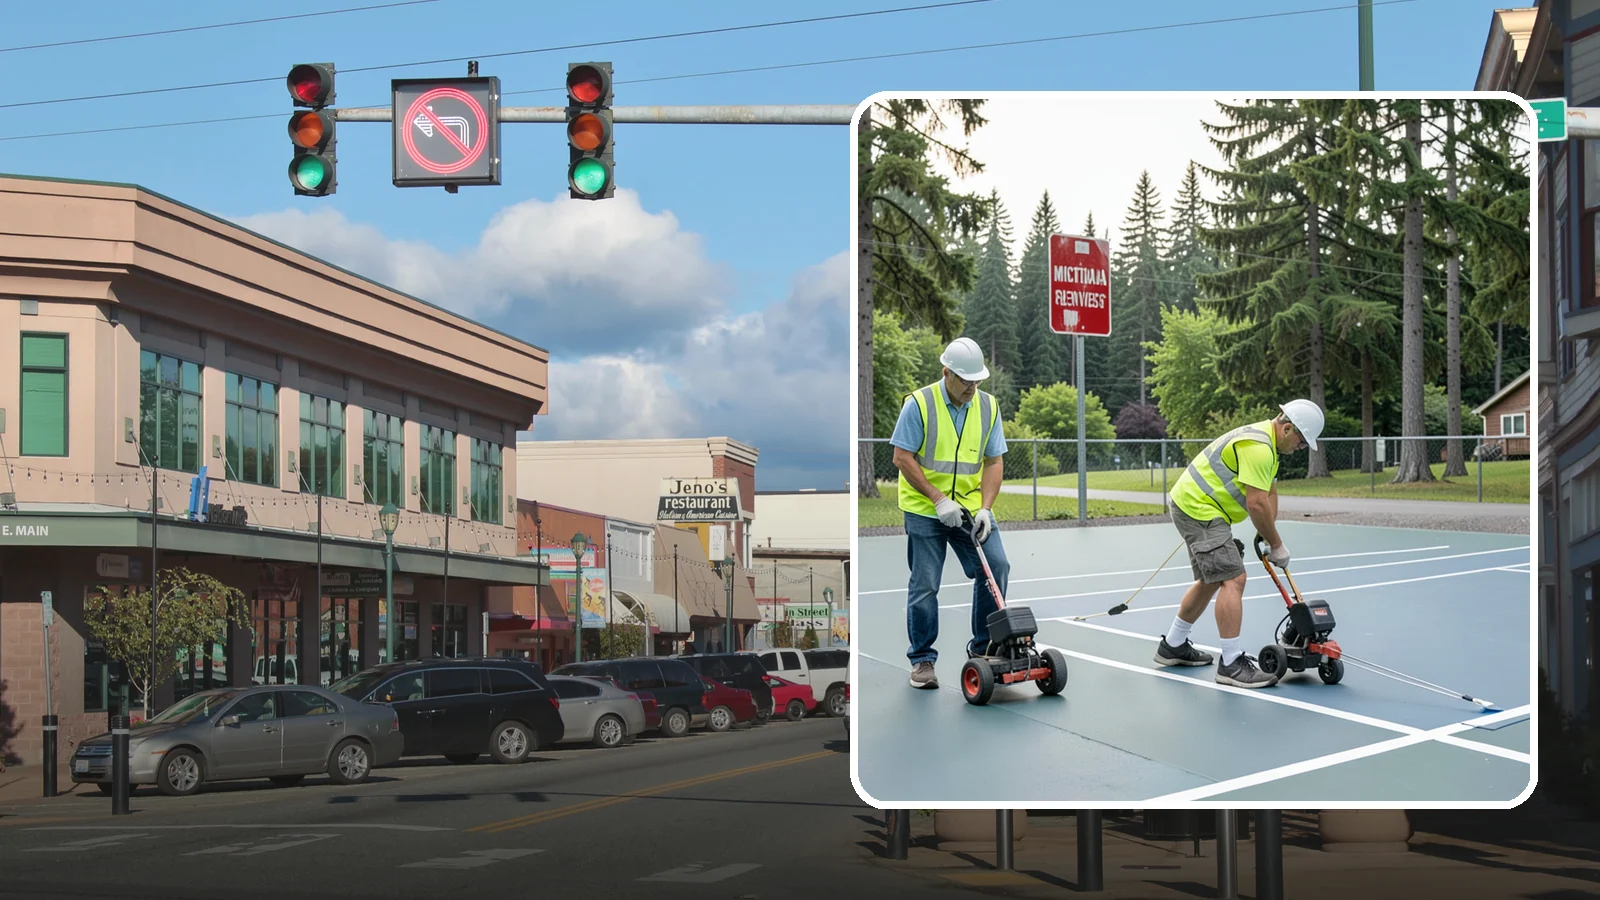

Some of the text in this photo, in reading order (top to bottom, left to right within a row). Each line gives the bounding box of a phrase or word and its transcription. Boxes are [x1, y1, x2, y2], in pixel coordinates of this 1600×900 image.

[669, 480, 728, 494] Jeno's
[665, 496, 731, 509] restaurant
[715, 510, 737, 519] Cuisine
[15, 525, 49, 536] MAIN
[797, 608, 828, 616] Street
